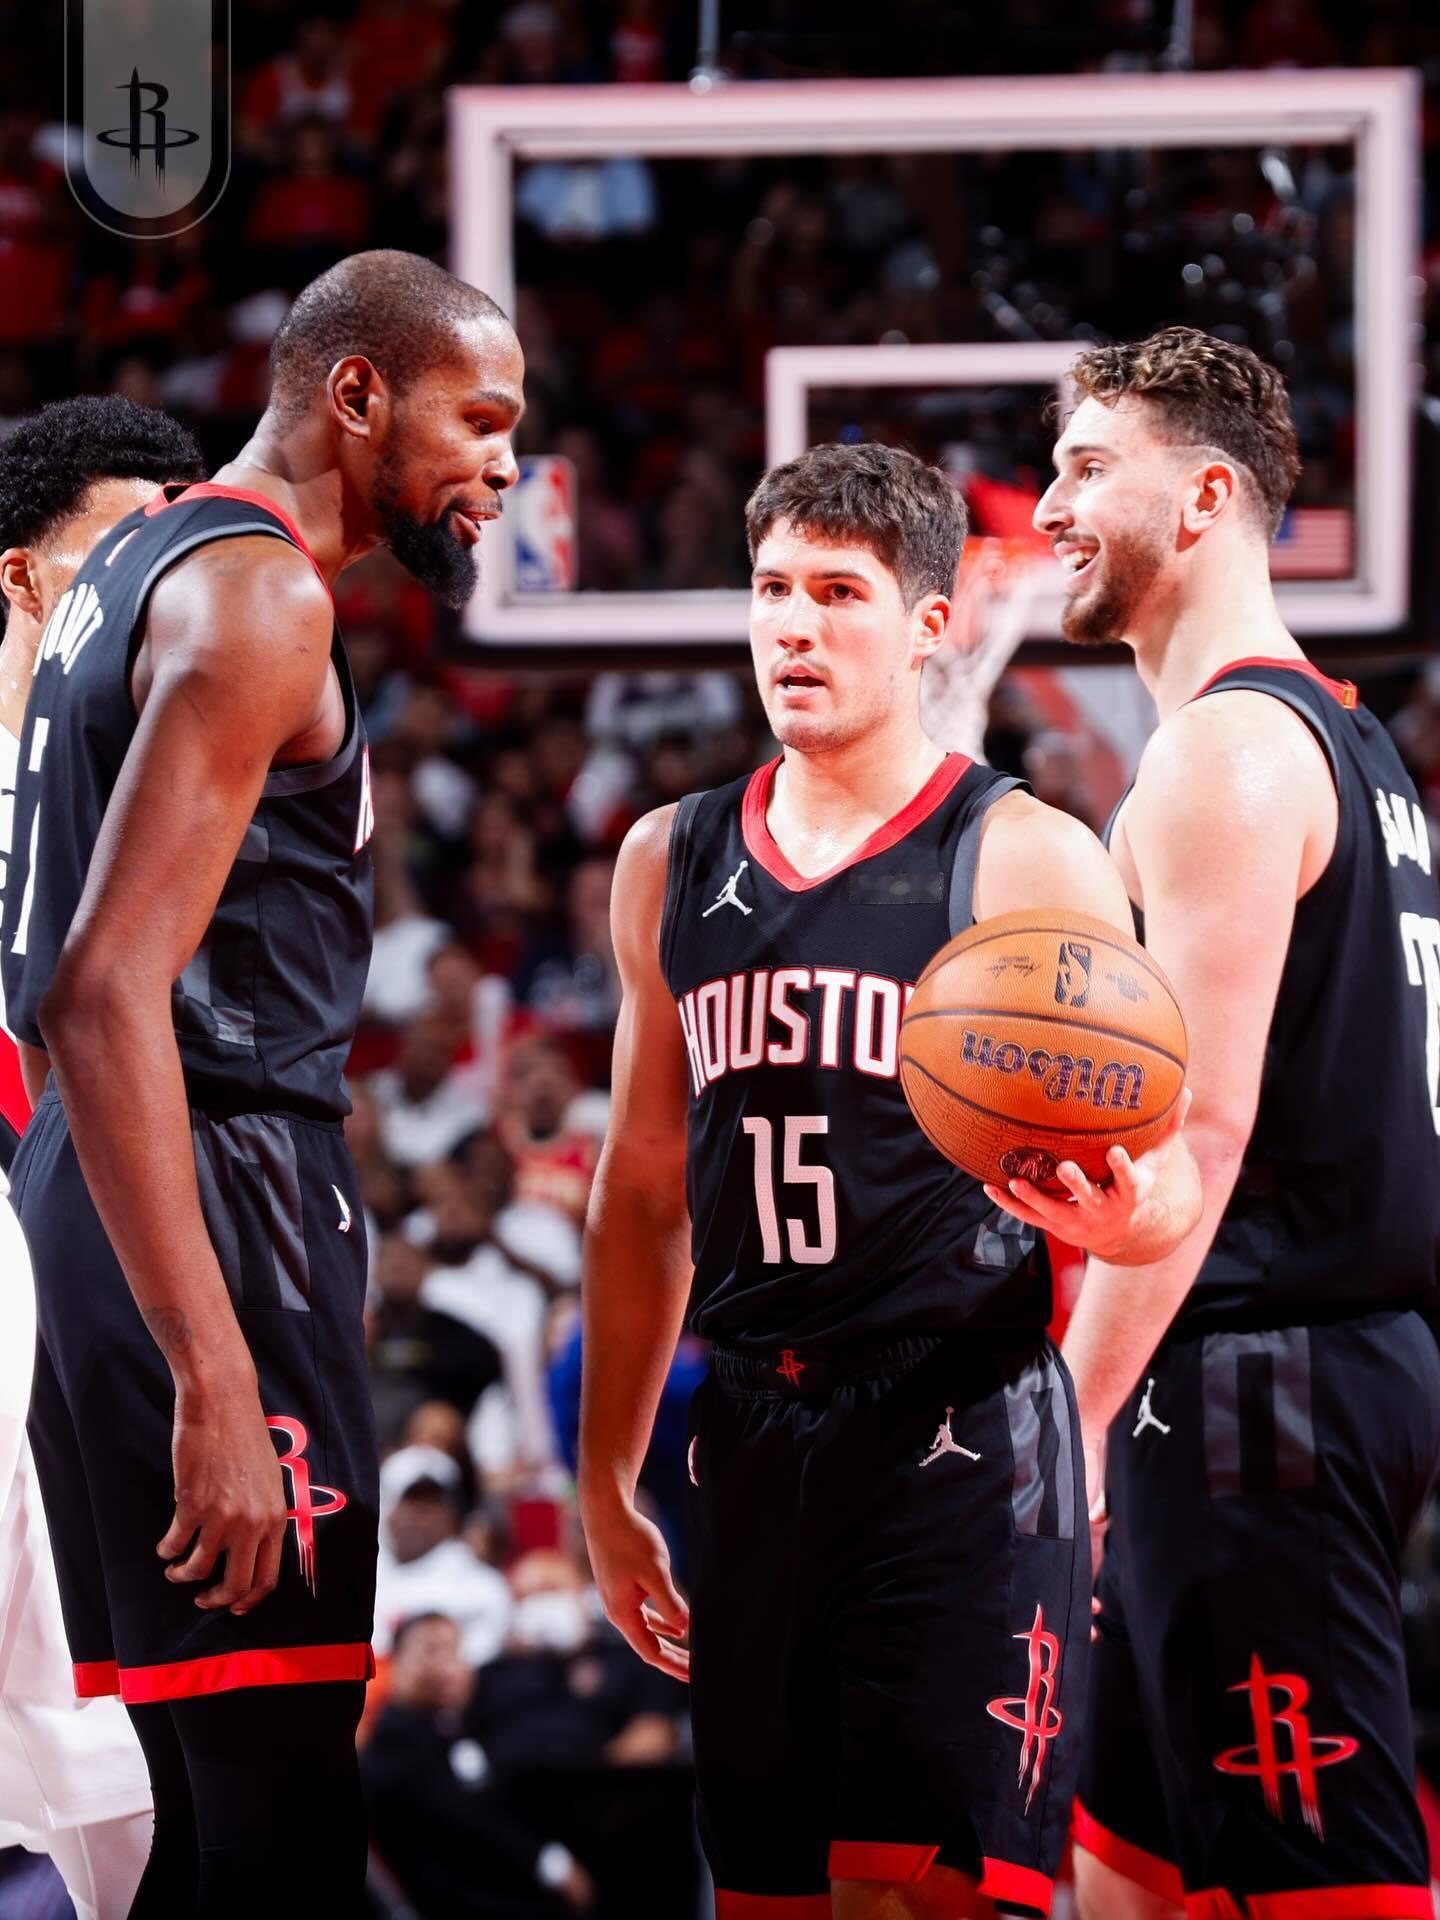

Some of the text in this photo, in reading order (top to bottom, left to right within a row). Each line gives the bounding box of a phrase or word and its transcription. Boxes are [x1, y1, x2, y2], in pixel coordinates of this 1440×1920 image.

[678, 966, 917, 1100] HOUSTO
[961, 1029, 1145, 1111] Wilson
[742, 1115, 837, 1264] 15
